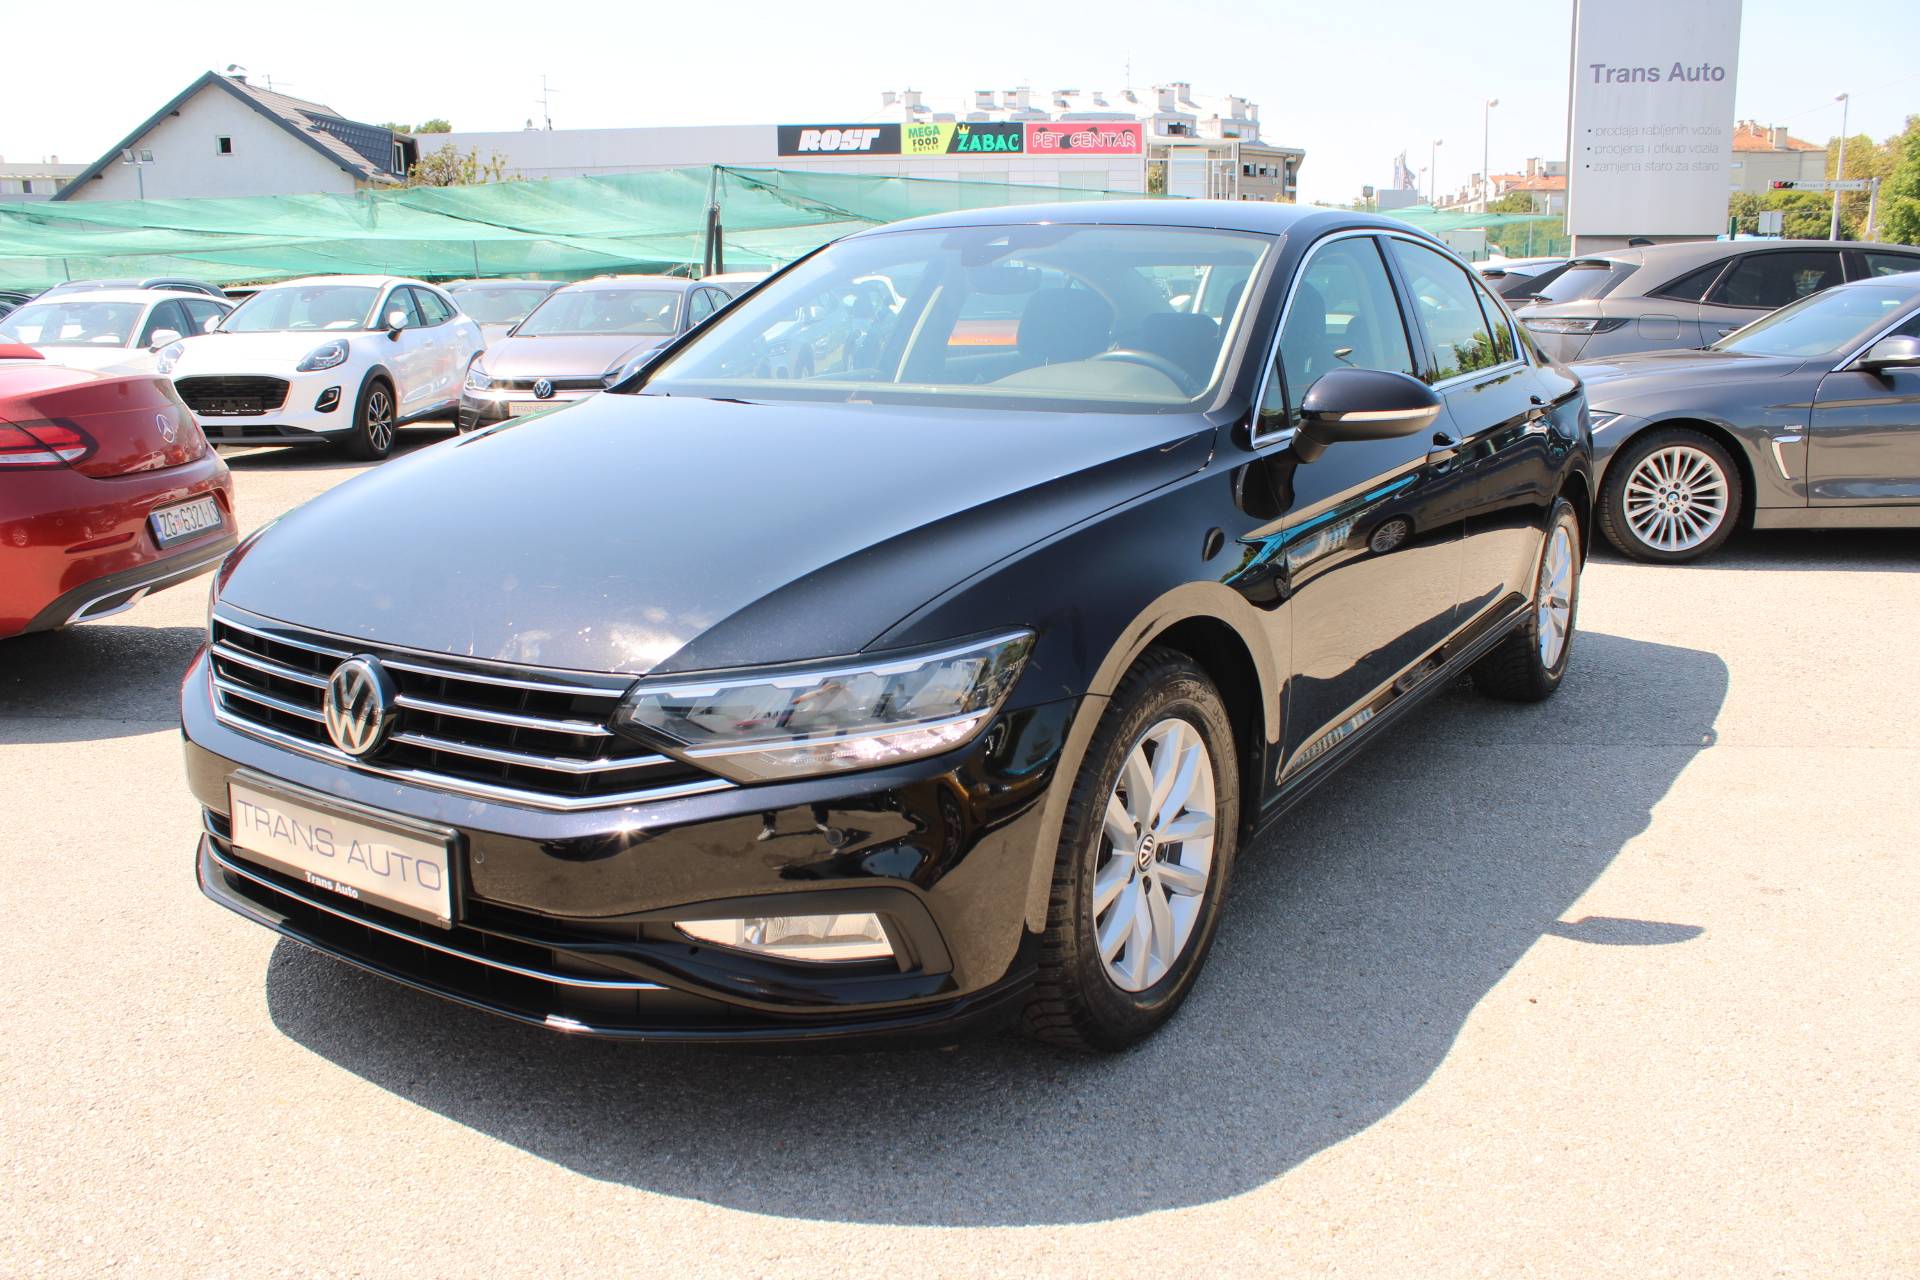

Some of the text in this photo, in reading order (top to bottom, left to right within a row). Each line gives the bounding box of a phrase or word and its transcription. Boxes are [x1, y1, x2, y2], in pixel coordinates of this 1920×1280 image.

[1590, 62, 1725, 84] Trans Auto
[798, 128, 880, 151] ROST
[908, 125, 941, 139] MEGA
[1032, 131, 1136, 148] PET CENTAR
[1595, 125, 1638, 138] prodaja
[1691, 124, 1721, 135] vozila
[912, 136, 939, 147] FOOD
[1689, 142, 1719, 153] vozila
[1592, 160, 1720, 174] zamjena staro za staro
[159, 512, 178, 538] ZG
[237, 799, 442, 892] TRANS AUTO
[305, 871, 359, 899] Trans Auto
